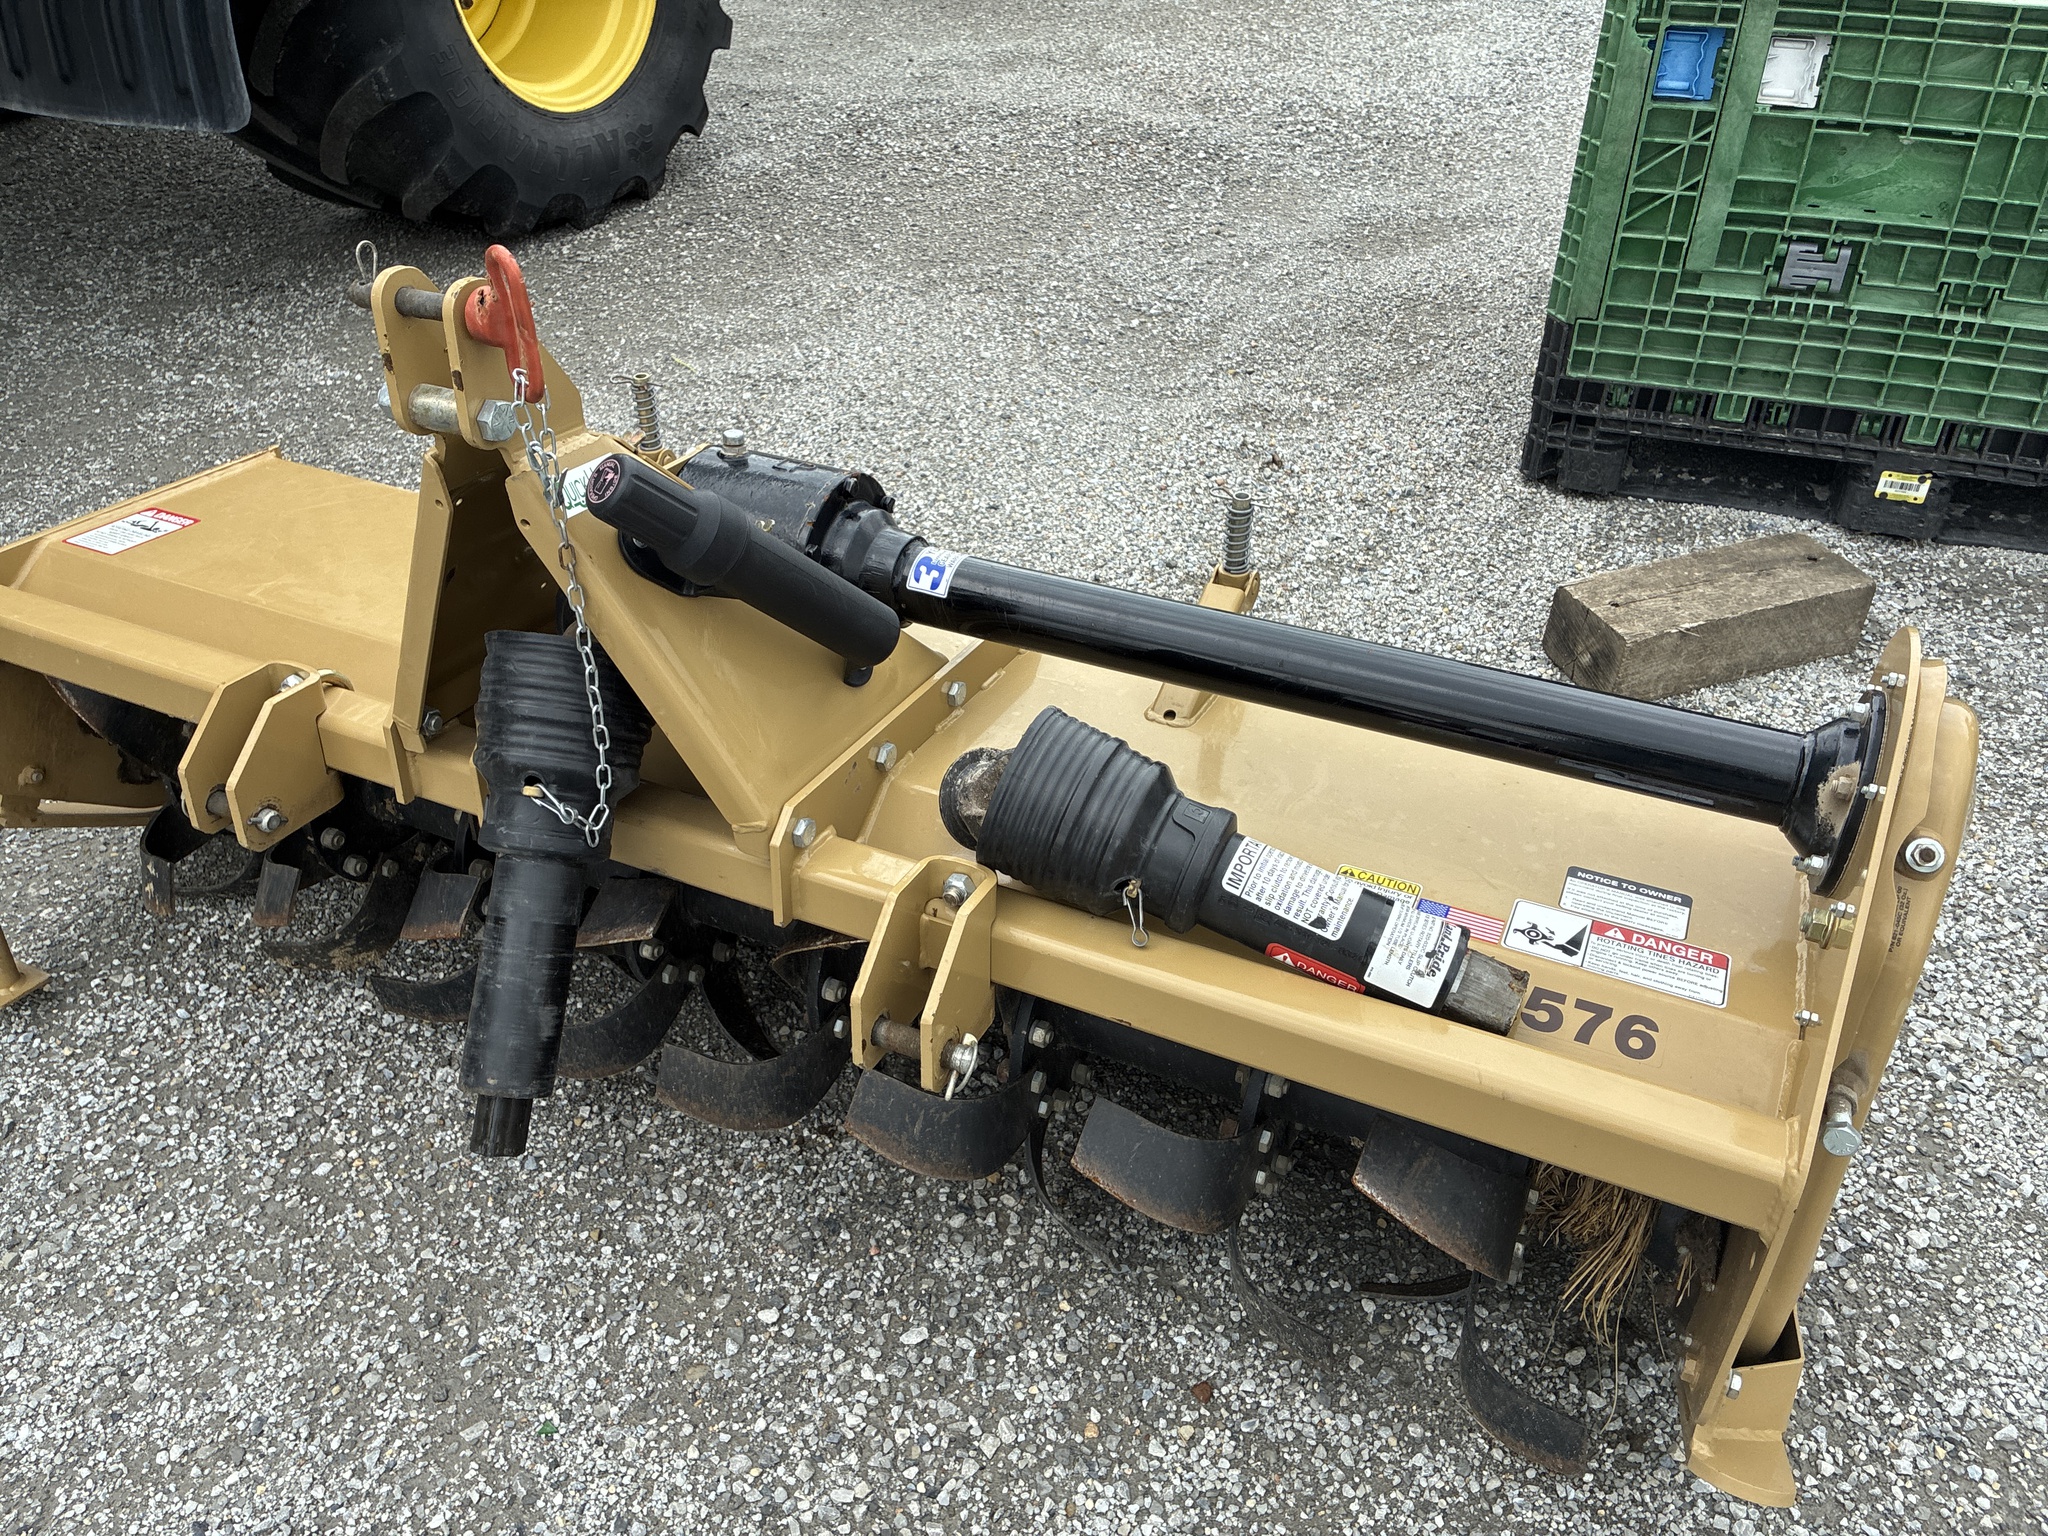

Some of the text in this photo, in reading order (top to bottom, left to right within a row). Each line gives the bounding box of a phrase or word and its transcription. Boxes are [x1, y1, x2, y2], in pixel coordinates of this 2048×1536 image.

[429, 43, 622, 182] ALLIANCE
[914, 556, 946, 590] 3
[1244, 880, 1257, 897] Prior
[1253, 872, 1261, 880] to
[1255, 885, 1266, 902] after
[1261, 876, 1271, 885] 10
[1266, 863, 1278, 877] days
[1264, 893, 1275, 906] slip
[1270, 873, 1284, 893] clutch
[1274, 880, 1292, 910] oxidation
[1282, 889, 1300, 915] damage
[1295, 881, 1303, 889] to
[1357, 871, 1417, 894] CAUTION
[1577, 871, 1681, 903] NOTICE TO OWNER
[1292, 884, 1314, 920] result. This
[1300, 907, 1313, 924] NOT
[1309, 883, 1325, 908] covered
[1330, 898, 1353, 938] maintenance.
[1896, 897, 1912, 947] OR EQUIVALENT
[1391, 934, 1400, 947] TUBE
[1415, 930, 1425, 949] ROTARY
[1596, 936, 1719, 974] ROTATING TINES HAZARD
[1632, 933, 1713, 964] DANGER
[1397, 951, 1406, 965] DAILY
[1405, 949, 1417, 970] TILLERS
[1296, 961, 1357, 991] DANGER
[1405, 965, 1418, 987] CLUTCH
[1521, 987, 1659, 1059] 576
